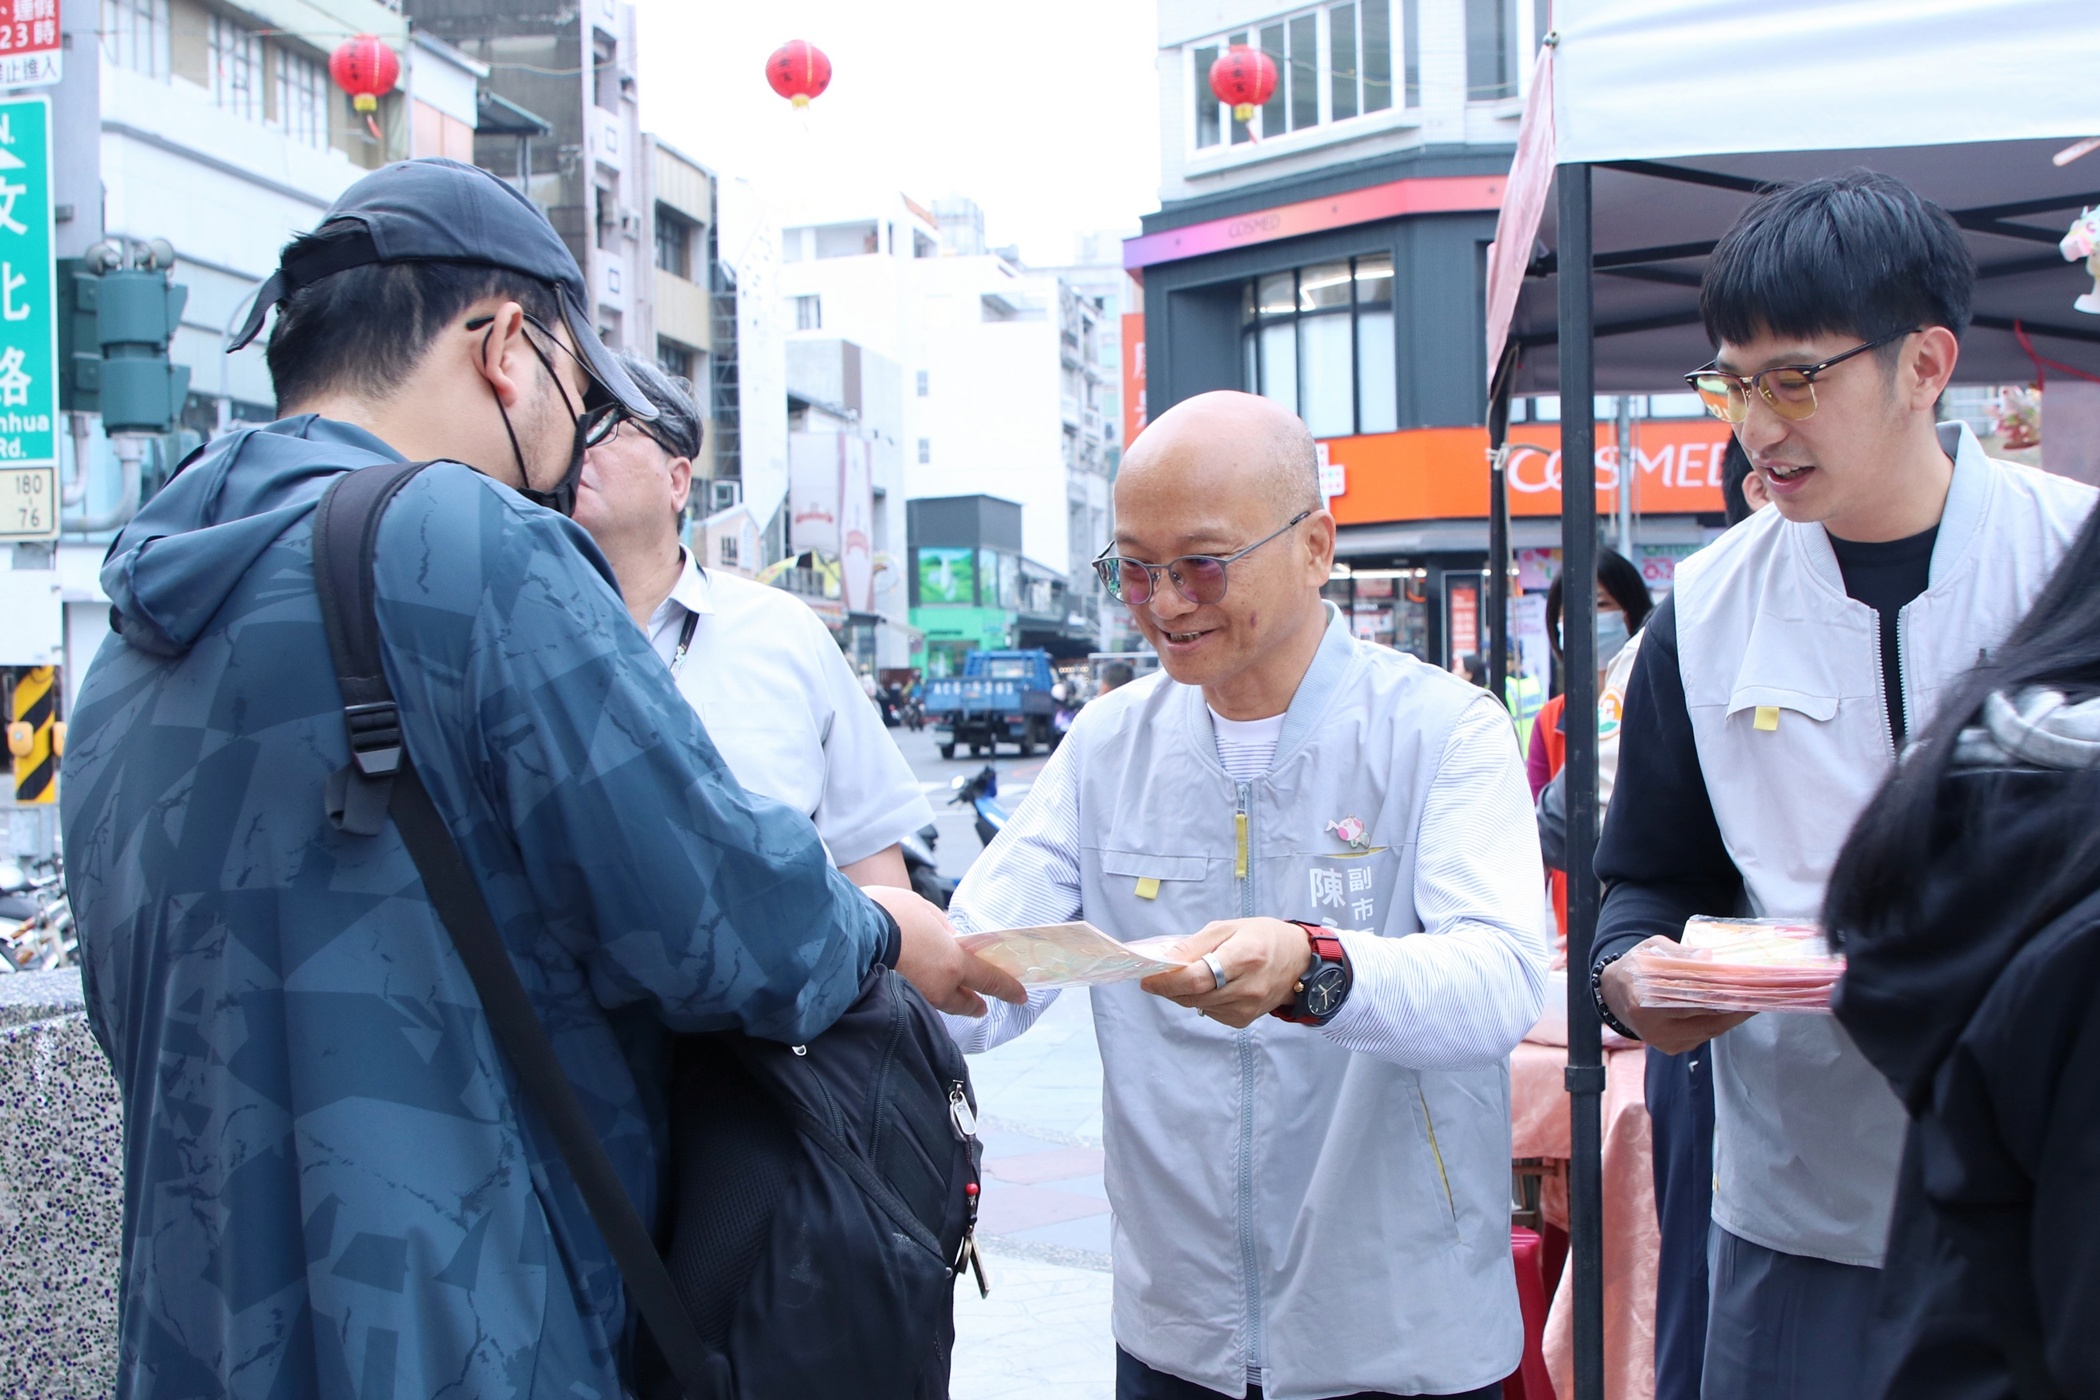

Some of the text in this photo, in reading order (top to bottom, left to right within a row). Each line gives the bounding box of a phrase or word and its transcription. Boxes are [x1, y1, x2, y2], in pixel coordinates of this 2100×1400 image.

[0, 55, 58, 84] 止進入
[16, 474, 42, 494] 180
[19, 508, 40, 528] 76
[1347, 866, 1374, 934] 副市
